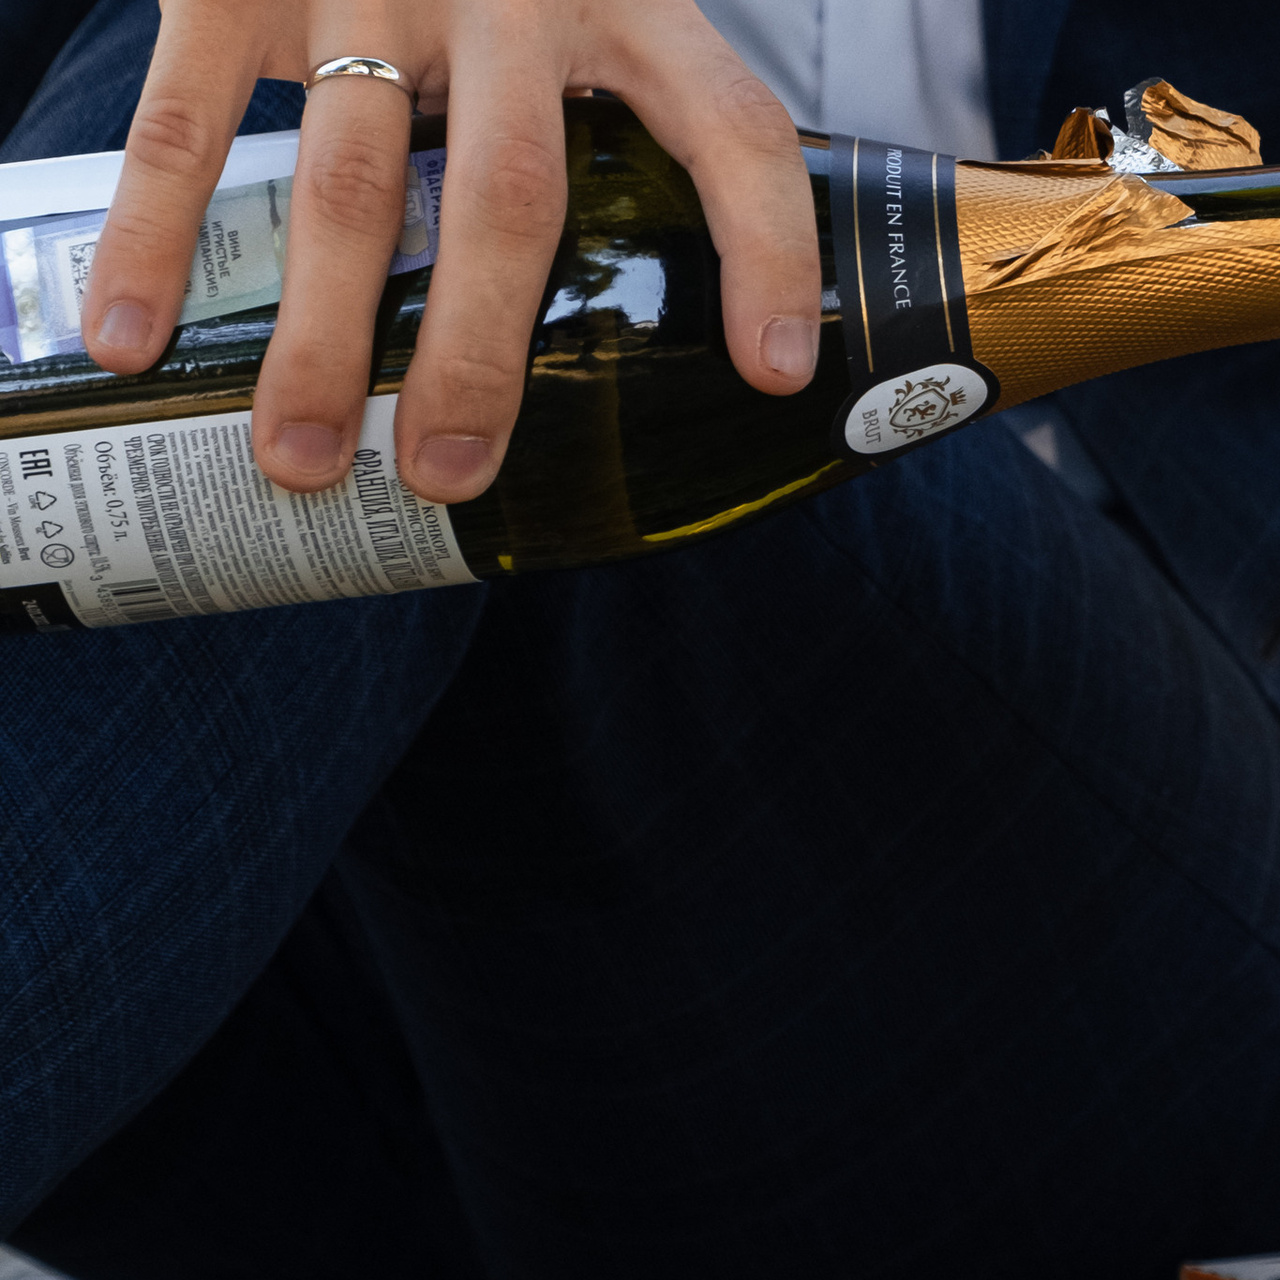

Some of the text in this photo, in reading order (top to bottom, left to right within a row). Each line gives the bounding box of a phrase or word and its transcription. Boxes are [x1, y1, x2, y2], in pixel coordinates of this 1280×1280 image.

[887, 204, 903, 225] EN
[211, 220, 230, 279] ИГРИСТЫЕ
[227, 230, 242, 261] ВИНА
[889, 233, 912, 309] FRANCE
[146, 433, 167, 456] СРОК
[862, 408, 881, 445] BRUT
[64, 443, 82, 481] Объёмная
[124, 436, 150, 493] ЧРЕЗМЕРНОЕ
[151, 457, 176, 500] ГОДНОСТИ
[69, 482, 85, 499] доля
[94, 441, 128, 541] Объём: 0,75 л.
[352, 449, 397, 519] ФРАНЦИЯ,
[7, 502, 18, 515] Vin
[136, 494, 166, 552] УПОТРЕБЛЕНИЕ
[160, 501, 179, 512] НЕ
[403, 492, 427, 546] ИГРИСТОЕ
[9, 516, 24, 546] Mousseux
[164, 512, 190, 552] ОГРАНИЧЕН
[366, 519, 408, 564] ИТАЛИЯ,
[422, 506, 450, 560] КОНКОРД
[17, 547, 30, 560] Brut
